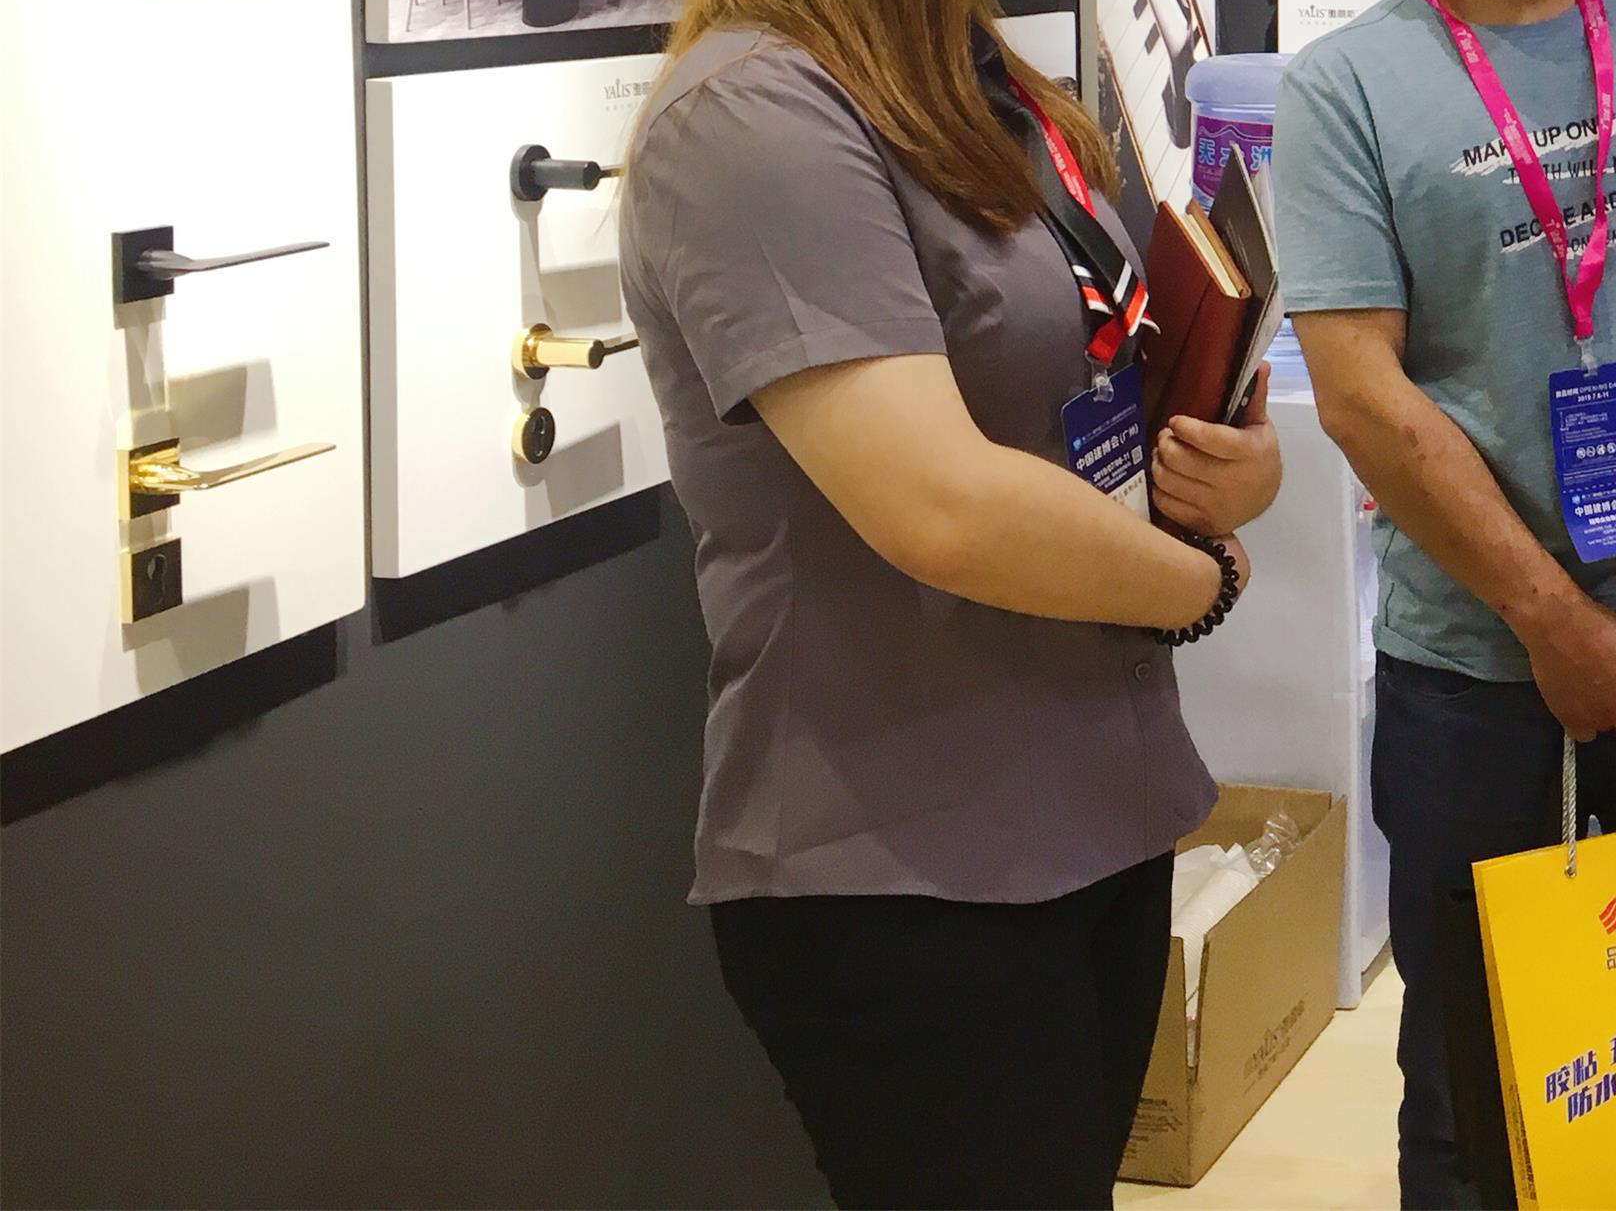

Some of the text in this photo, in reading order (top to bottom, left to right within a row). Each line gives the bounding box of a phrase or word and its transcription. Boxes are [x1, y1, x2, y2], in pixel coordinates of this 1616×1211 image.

[1298, 5, 1326, 18] YALIS
[604, 78, 631, 100] YALIS
[1463, 139, 1507, 167] MAK
[1533, 126, 1561, 148] UP
[1567, 159, 1606, 178] WIL
[1545, 1050, 1597, 1104] 胶粘
